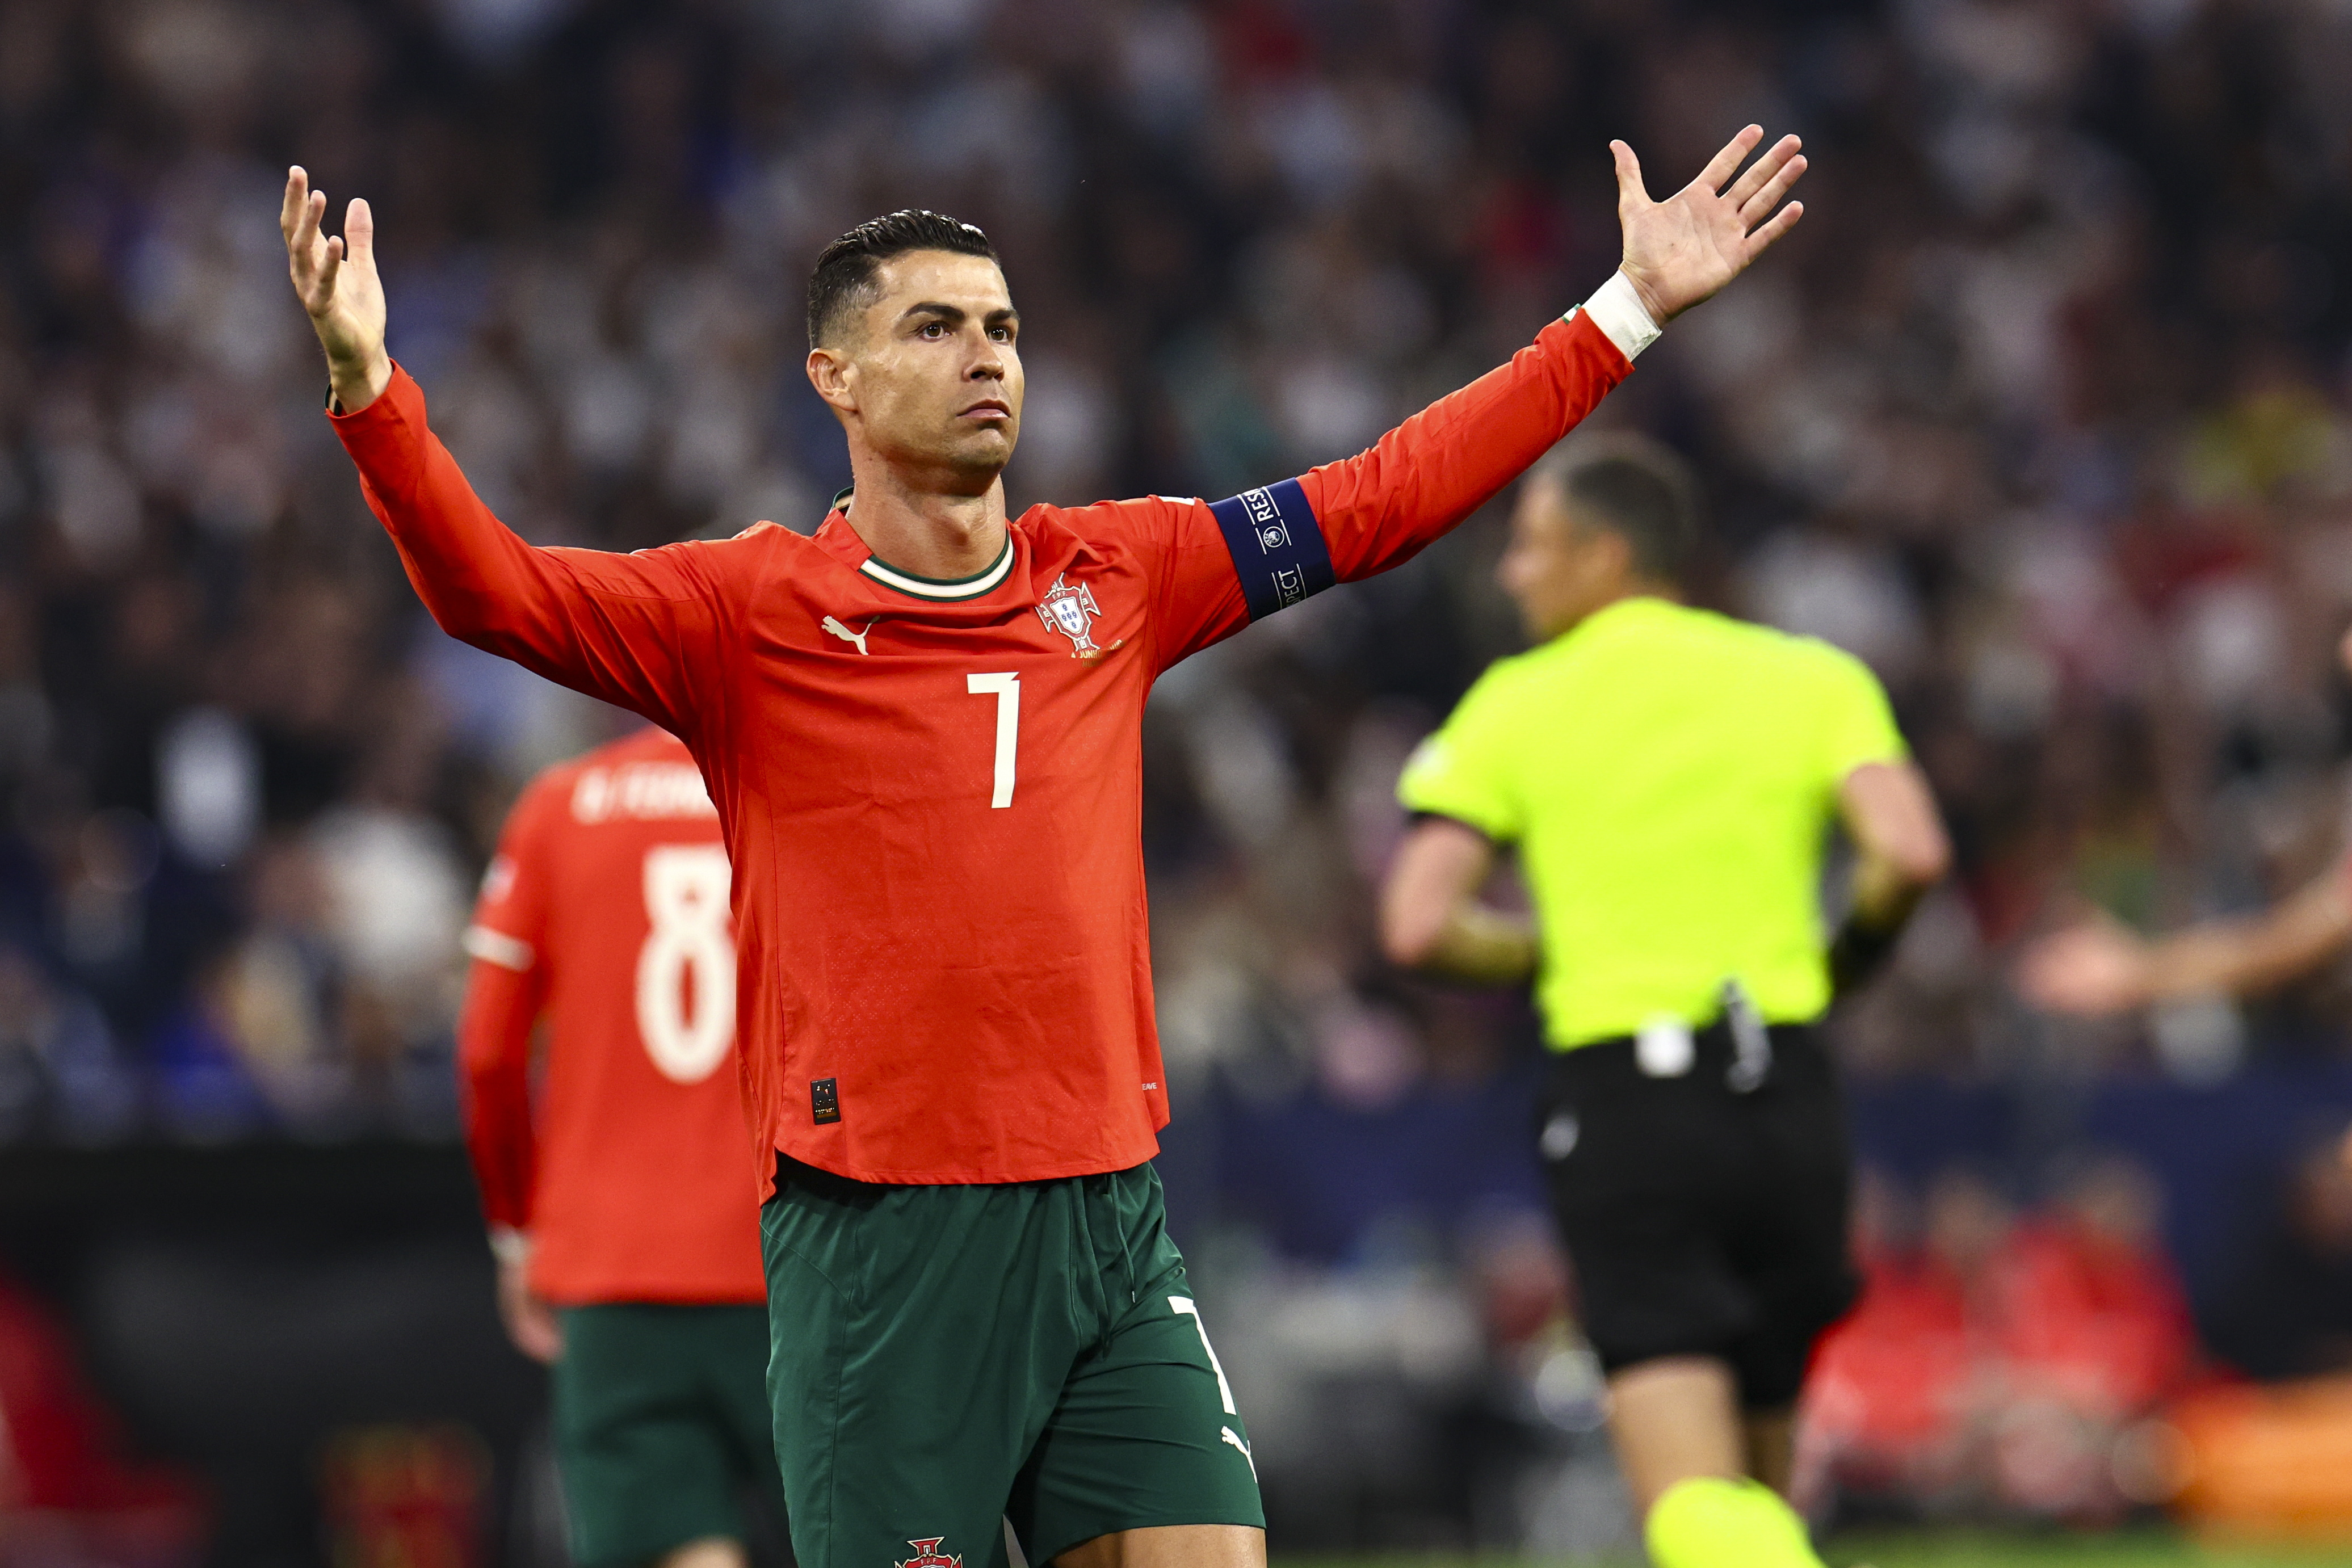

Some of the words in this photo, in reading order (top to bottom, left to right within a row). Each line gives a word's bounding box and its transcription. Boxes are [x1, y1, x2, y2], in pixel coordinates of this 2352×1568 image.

[1244, 489, 1274, 522] RES
[967, 671, 1020, 809] 7
[635, 843, 737, 1084] 8
[1167, 1296, 1237, 1415] 7
